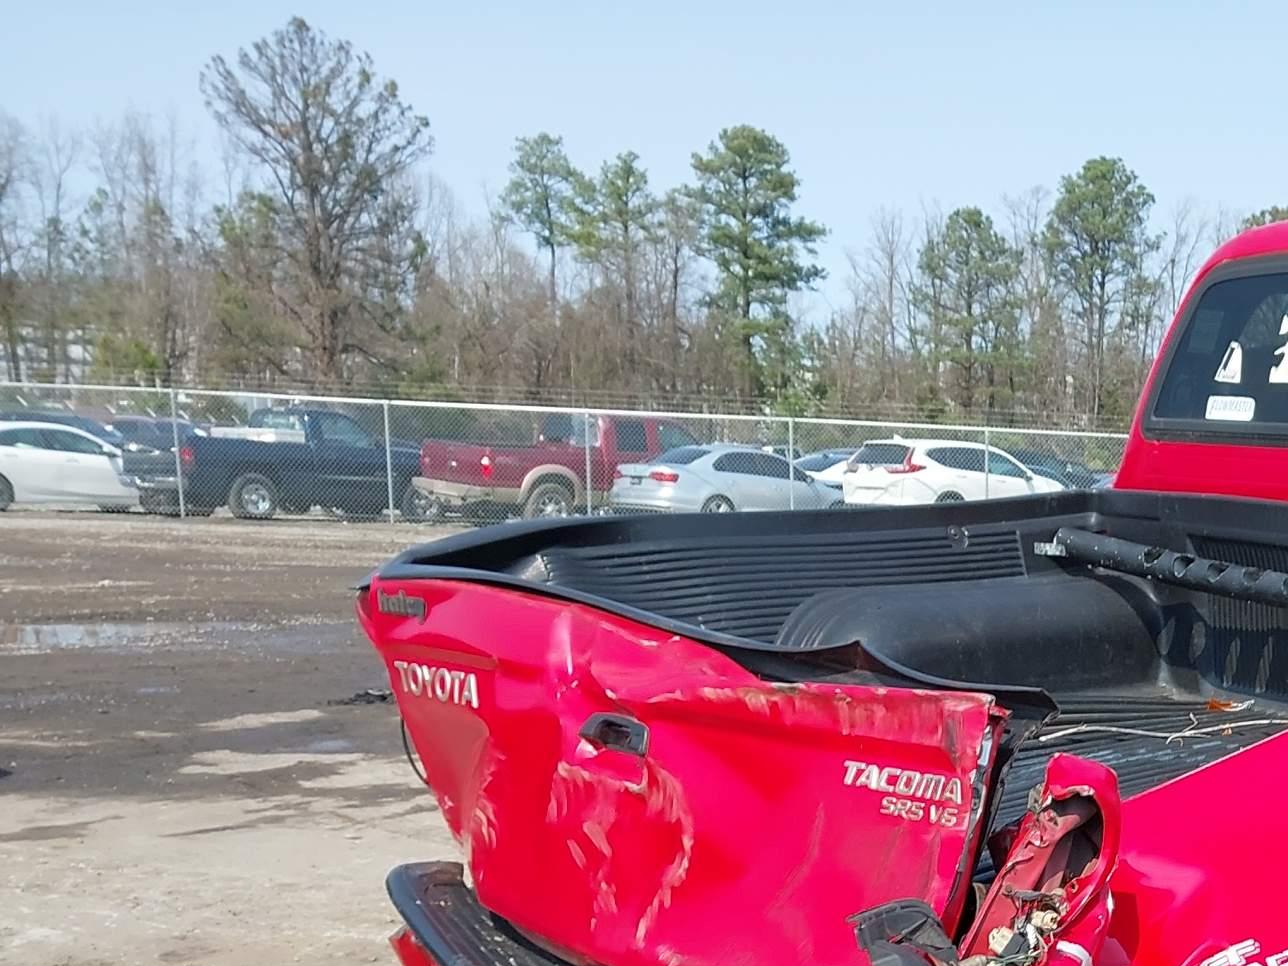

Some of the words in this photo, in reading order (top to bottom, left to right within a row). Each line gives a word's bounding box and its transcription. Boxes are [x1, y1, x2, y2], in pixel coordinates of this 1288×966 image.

[393, 660, 480, 709] TOYOTA
[843, 759, 963, 805] TACOMA
[880, 796, 926, 822] SR5
